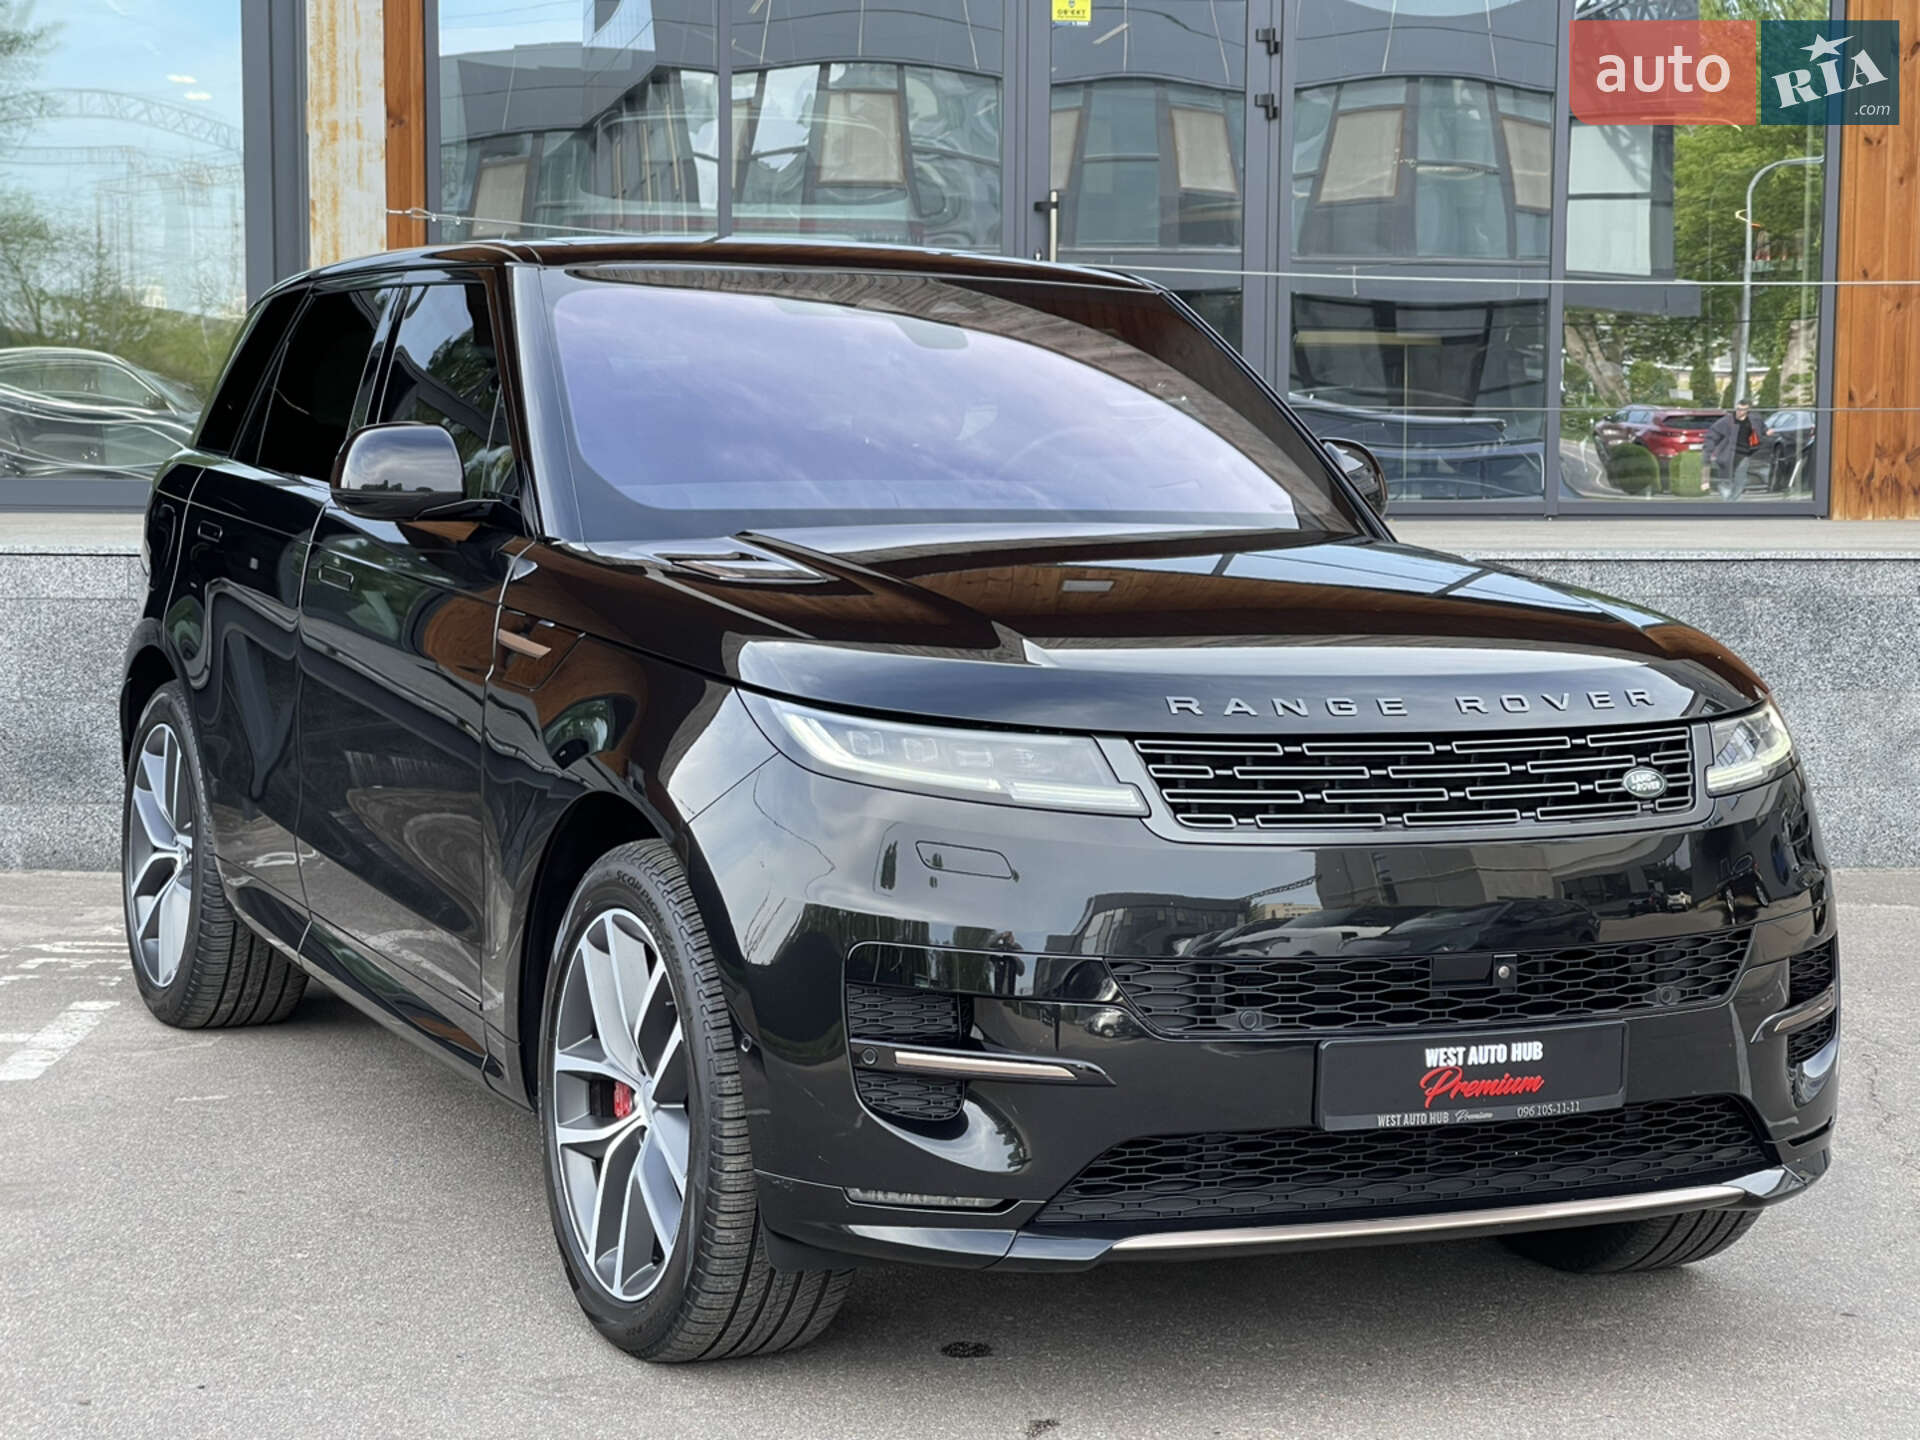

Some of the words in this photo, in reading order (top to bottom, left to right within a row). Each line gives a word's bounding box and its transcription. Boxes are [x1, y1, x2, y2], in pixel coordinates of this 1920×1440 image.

[1166, 695, 1408, 717] RANGE
[1455, 688, 1655, 715] ROVER
[1425, 1046, 1466, 1067] WEST
[1467, 1044, 1507, 1065] AUTO
[1511, 1041, 1543, 1061] HUB
[1419, 1066, 1544, 1109] Premium
[1377, 1114, 1402, 1127] WEST
[1403, 1112, 1427, 1126] AUTO
[1429, 1111, 1449, 1124] HUB
[1455, 1109, 1493, 1123] Premium
[1517, 1105, 1535, 1118] 096
[1537, 1101, 1580, 1116] 105-11-11
